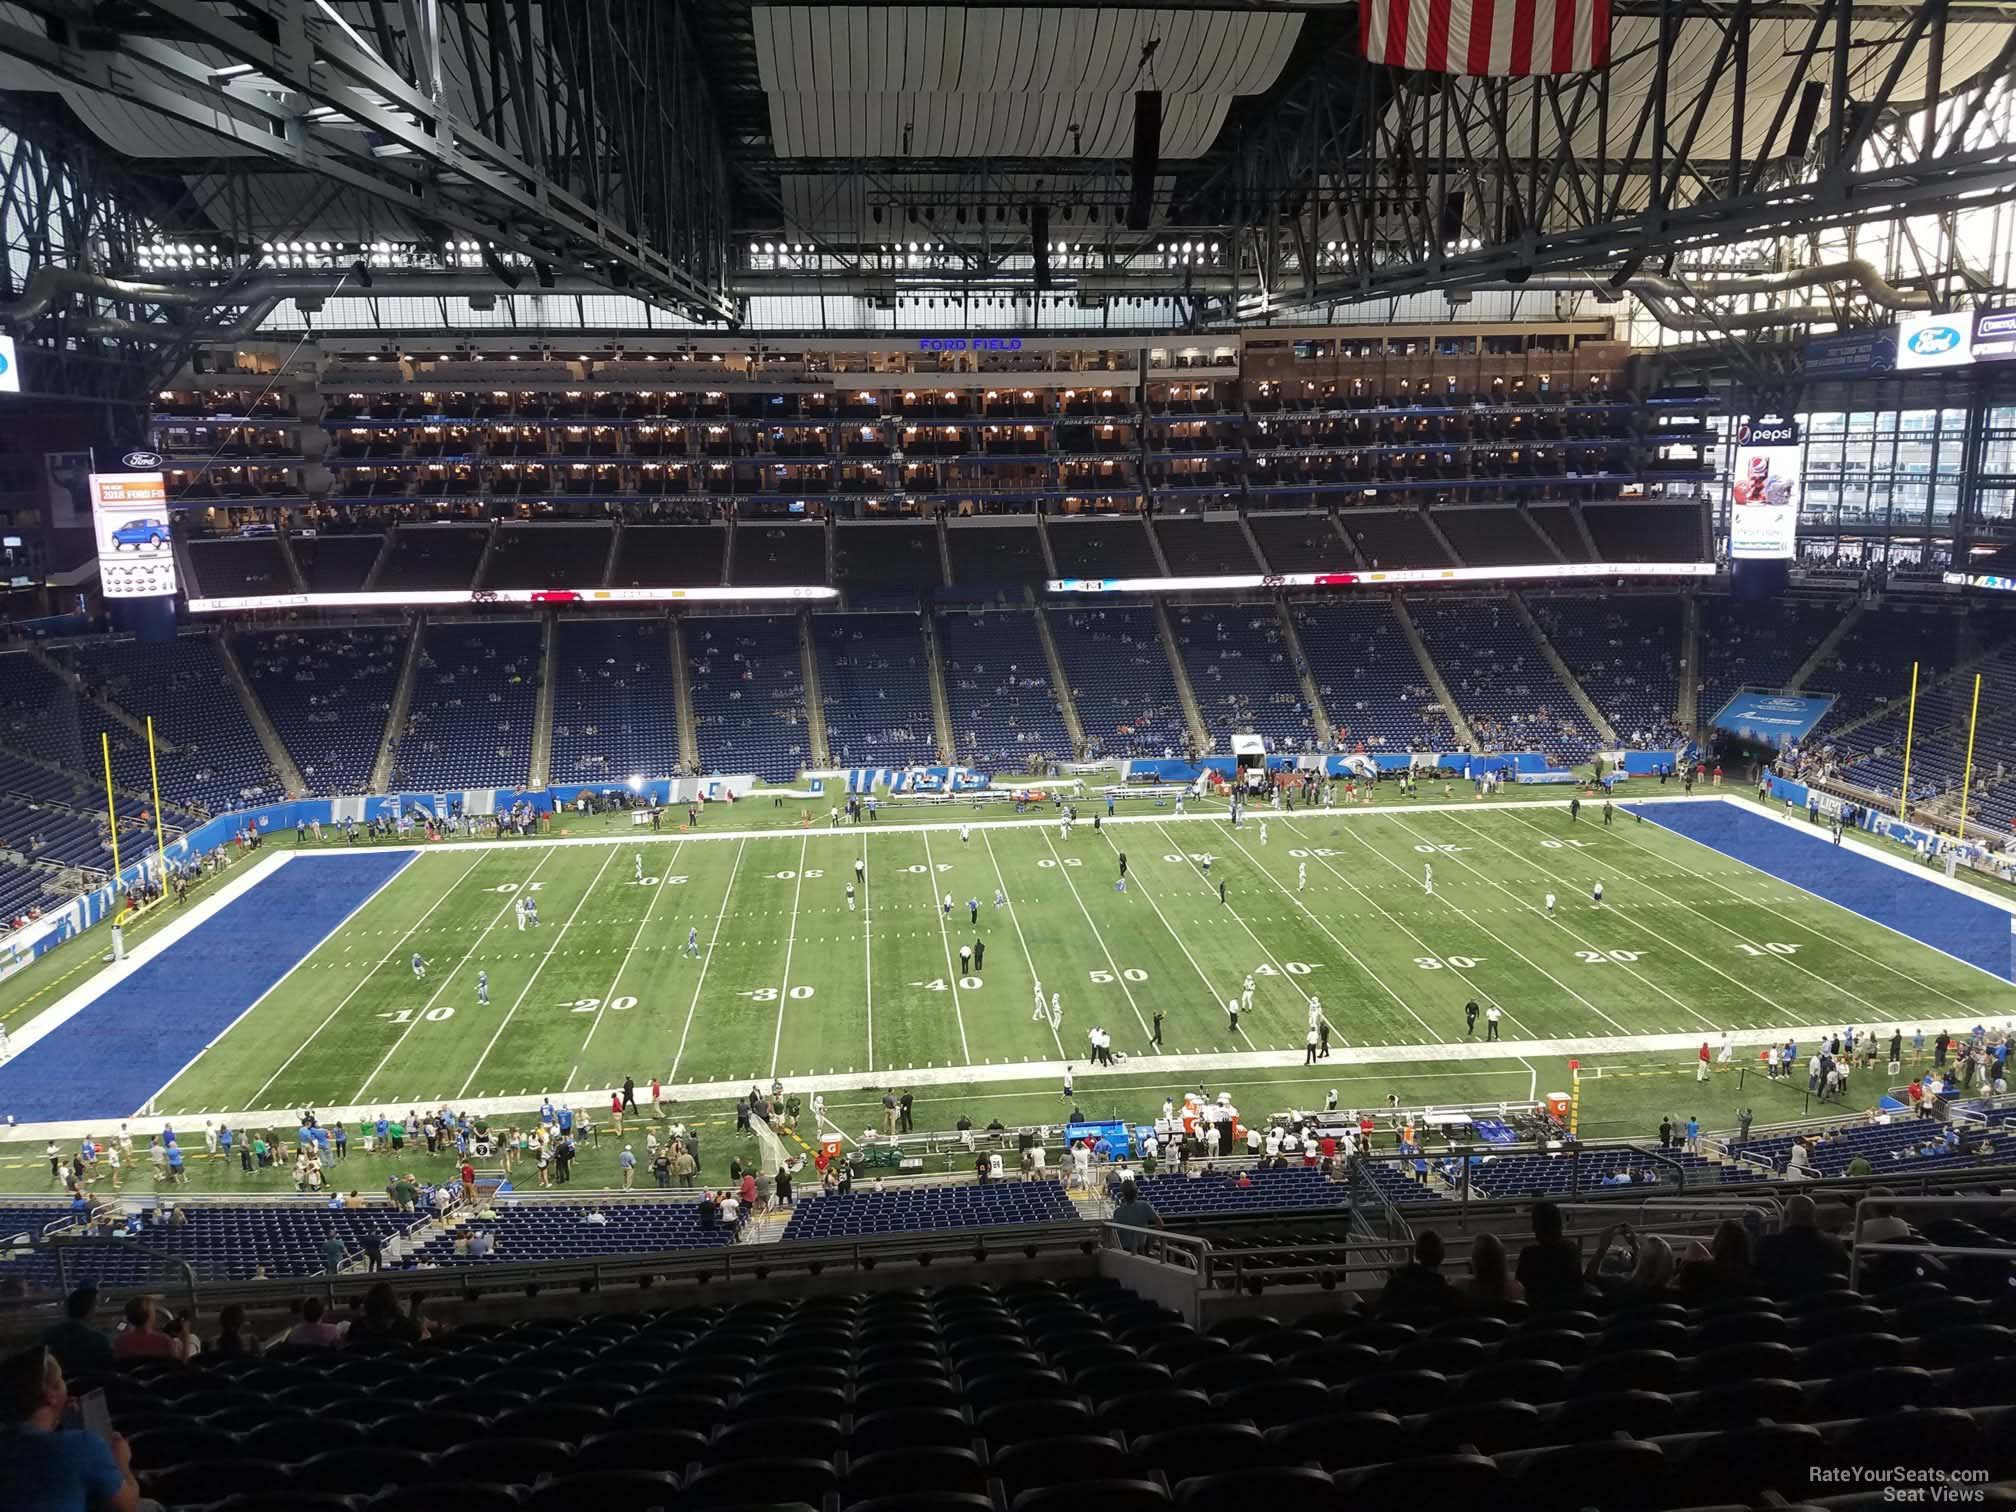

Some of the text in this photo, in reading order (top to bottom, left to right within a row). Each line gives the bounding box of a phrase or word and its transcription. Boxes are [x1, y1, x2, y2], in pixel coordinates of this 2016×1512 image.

[919, 339, 1022, 351] FORD FIELD
[1752, 427, 1792, 442] pepsi
[130, 454, 155, 465] Ford
[1734, 942, 1796, 955] 10
[1413, 956, 1476, 969] 30
[1574, 949, 1638, 963] 20
[1255, 962, 1312, 975] 40
[1089, 968, 1148, 983] 50
[924, 976, 983, 991] 40
[752, 986, 815, 1001] 30
[570, 996, 638, 1012] 20
[388, 1007, 455, 1024] 10
[1557, 1103, 1566, 1111] G
[828, 1144, 836, 1153] G
